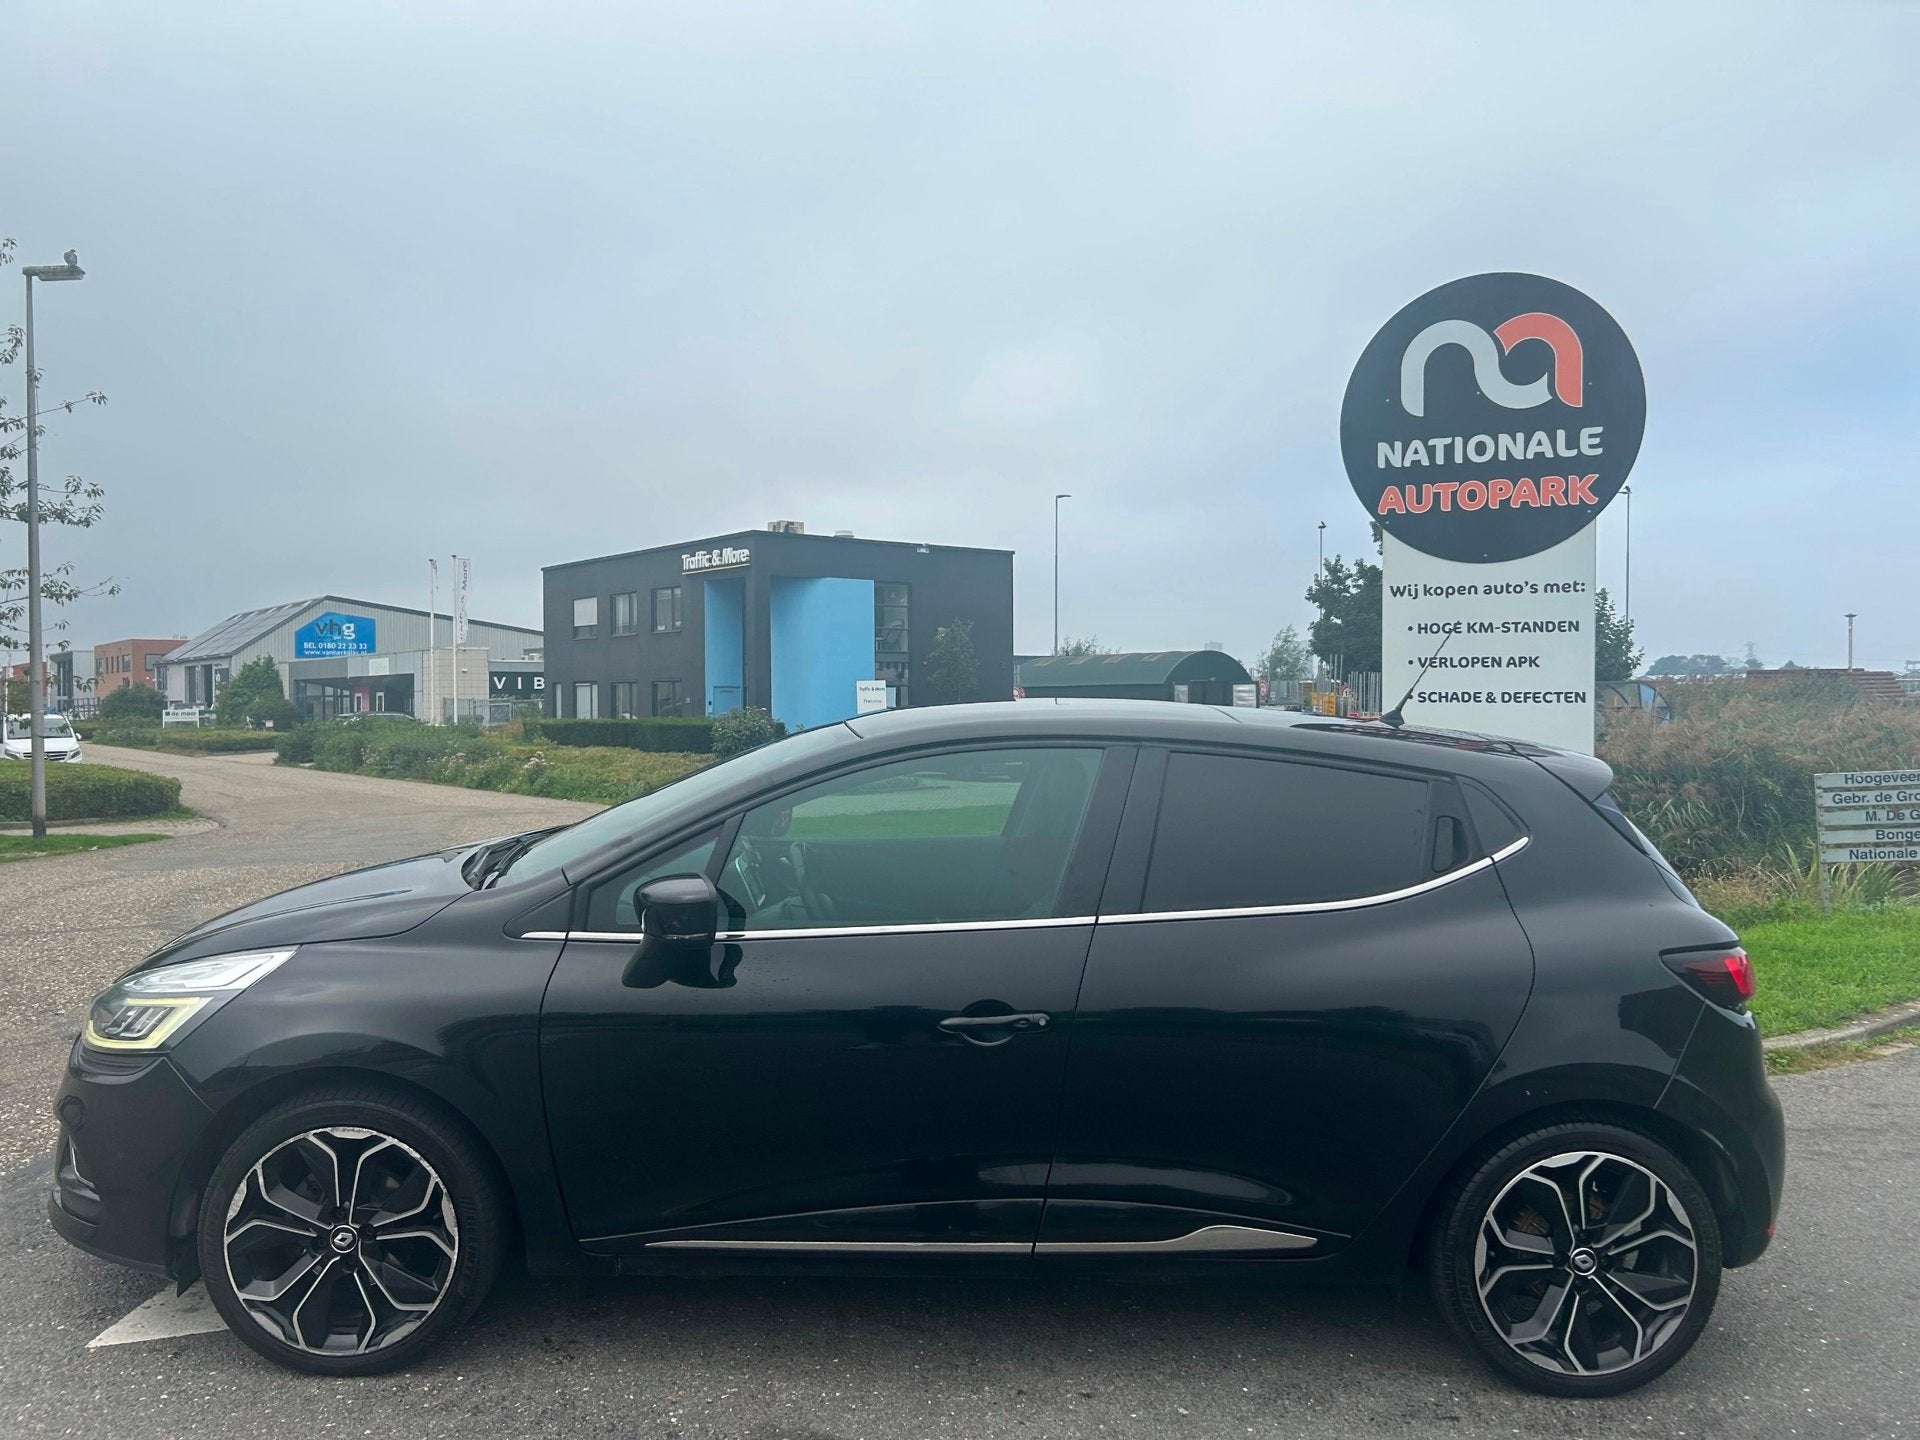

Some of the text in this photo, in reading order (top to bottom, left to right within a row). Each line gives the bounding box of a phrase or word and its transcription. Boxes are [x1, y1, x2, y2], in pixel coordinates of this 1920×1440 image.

[1377, 426, 1604, 469] NATIONALE
[1377, 473, 1600, 515] AUTOPARK
[681, 551, 711, 570] Traffic
[722, 547, 750, 564] More
[1389, 584, 1419, 600] Wij
[1423, 582, 1478, 599] kopen
[1543, 579, 1586, 594] met:
[316, 619, 356, 640] vhg
[1417, 620, 1580, 635] HOGE KM-STANDEN
[337, 642, 346, 650] 22
[1417, 655, 1540, 669] VERLOPEN APK
[1417, 691, 1586, 704] SCHADE & DEFECTEN
[1832, 792, 1870, 805] Gebr.
[1874, 791, 1893, 803] de
[1865, 810, 1881, 822] M.
[1886, 810, 1906, 821] De
[1849, 847, 1918, 860] Nationale
